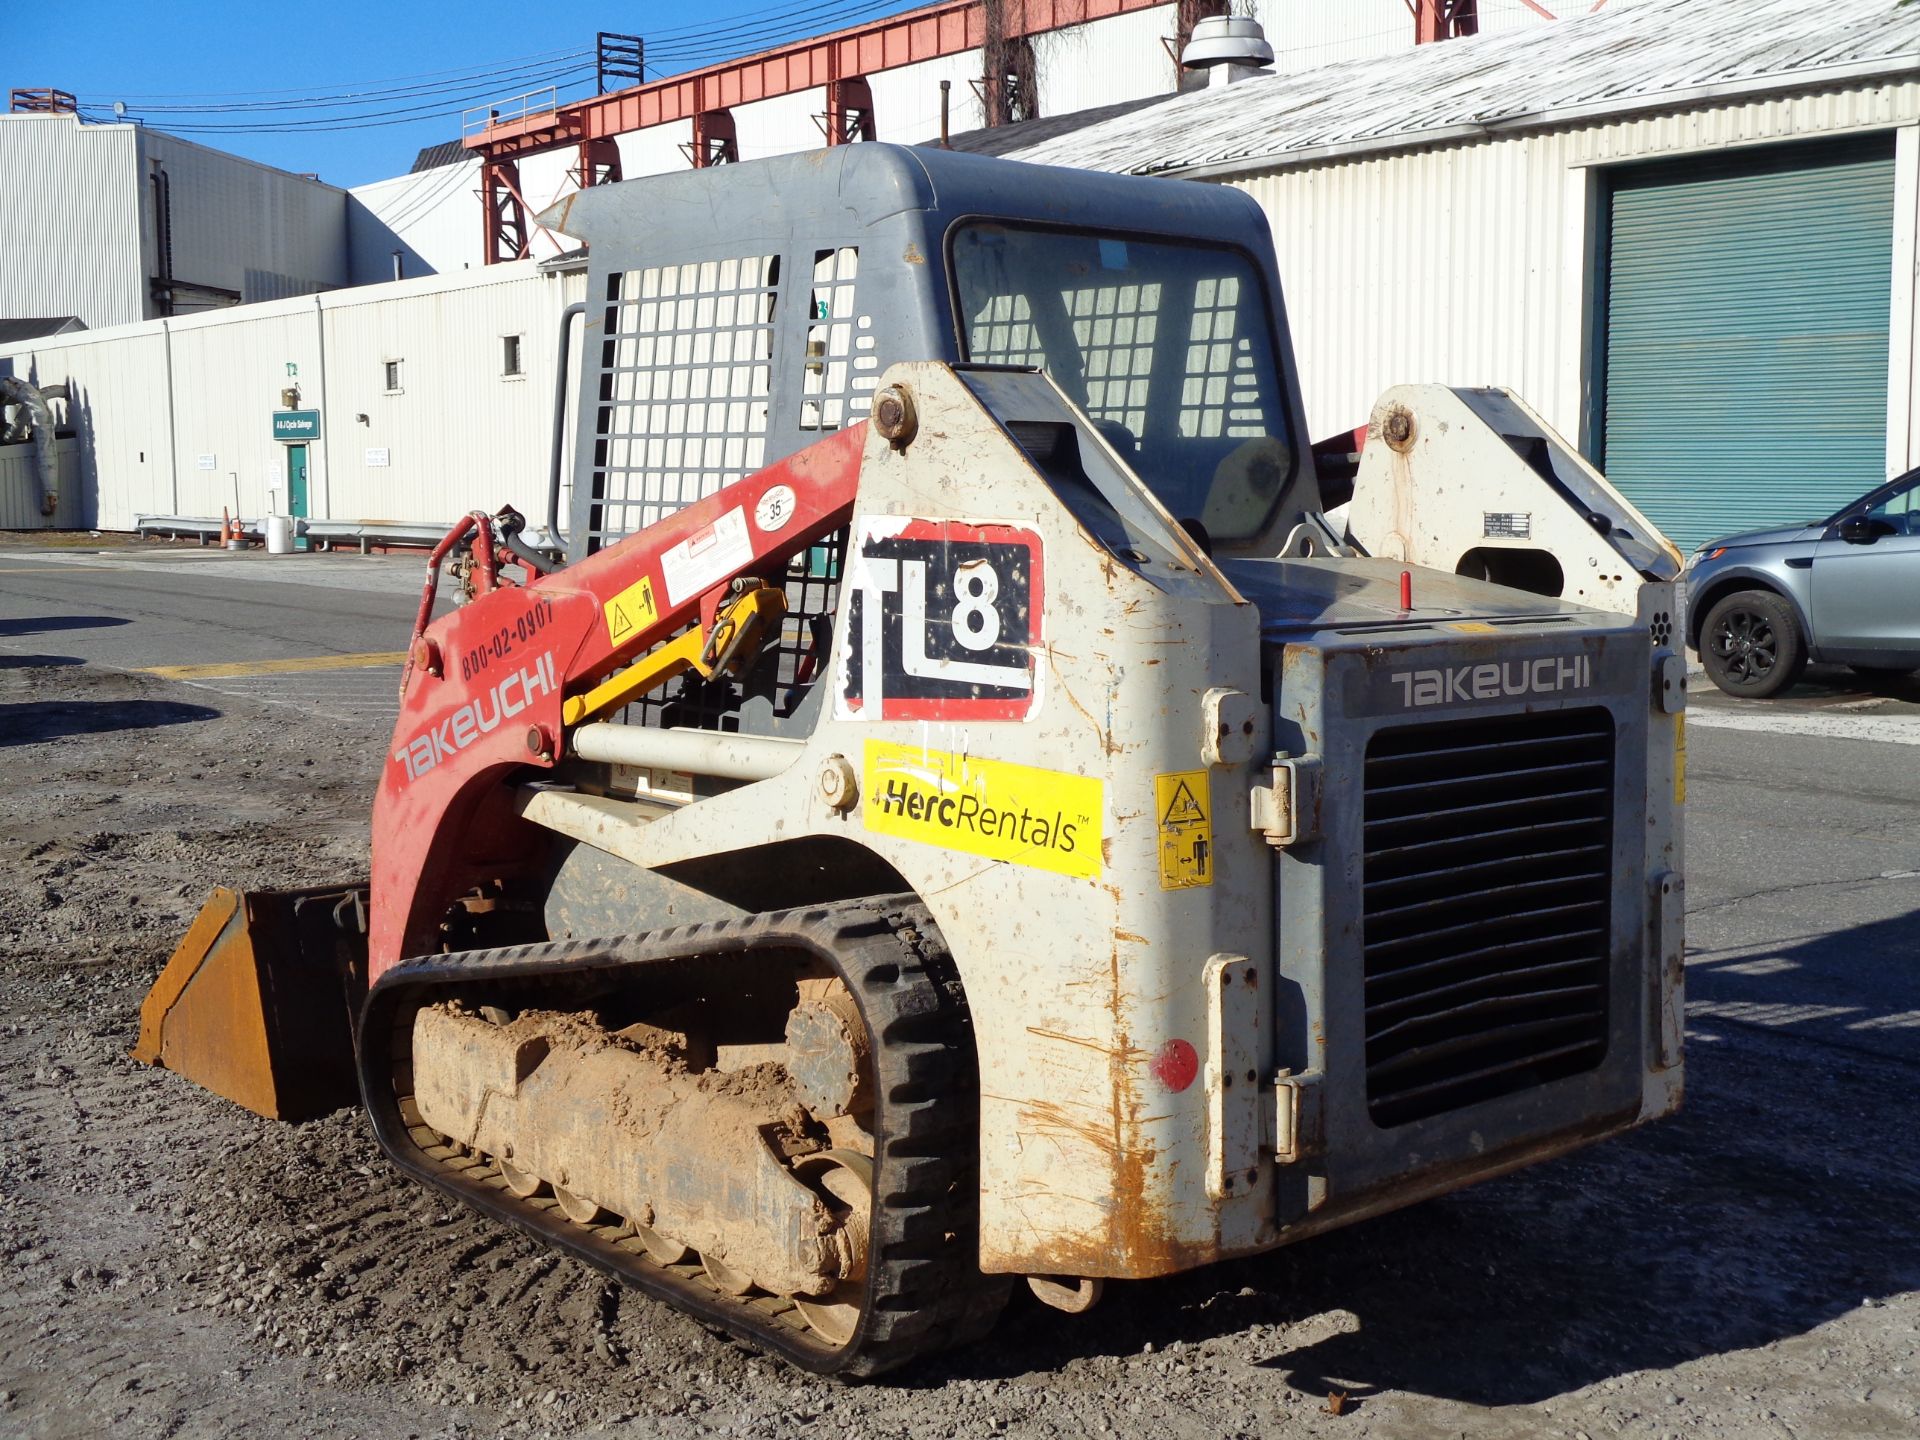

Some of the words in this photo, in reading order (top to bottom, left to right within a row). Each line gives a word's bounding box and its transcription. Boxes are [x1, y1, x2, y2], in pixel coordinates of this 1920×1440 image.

[770, 499, 782, 520] 35
[462, 600, 553, 682] 800-02-0907
[852, 556, 1032, 721] TL8
[394, 650, 559, 783] TAKEUCHI
[1391, 654, 1591, 708] TAKEUCHI
[883, 779, 1078, 853] HercRentals
